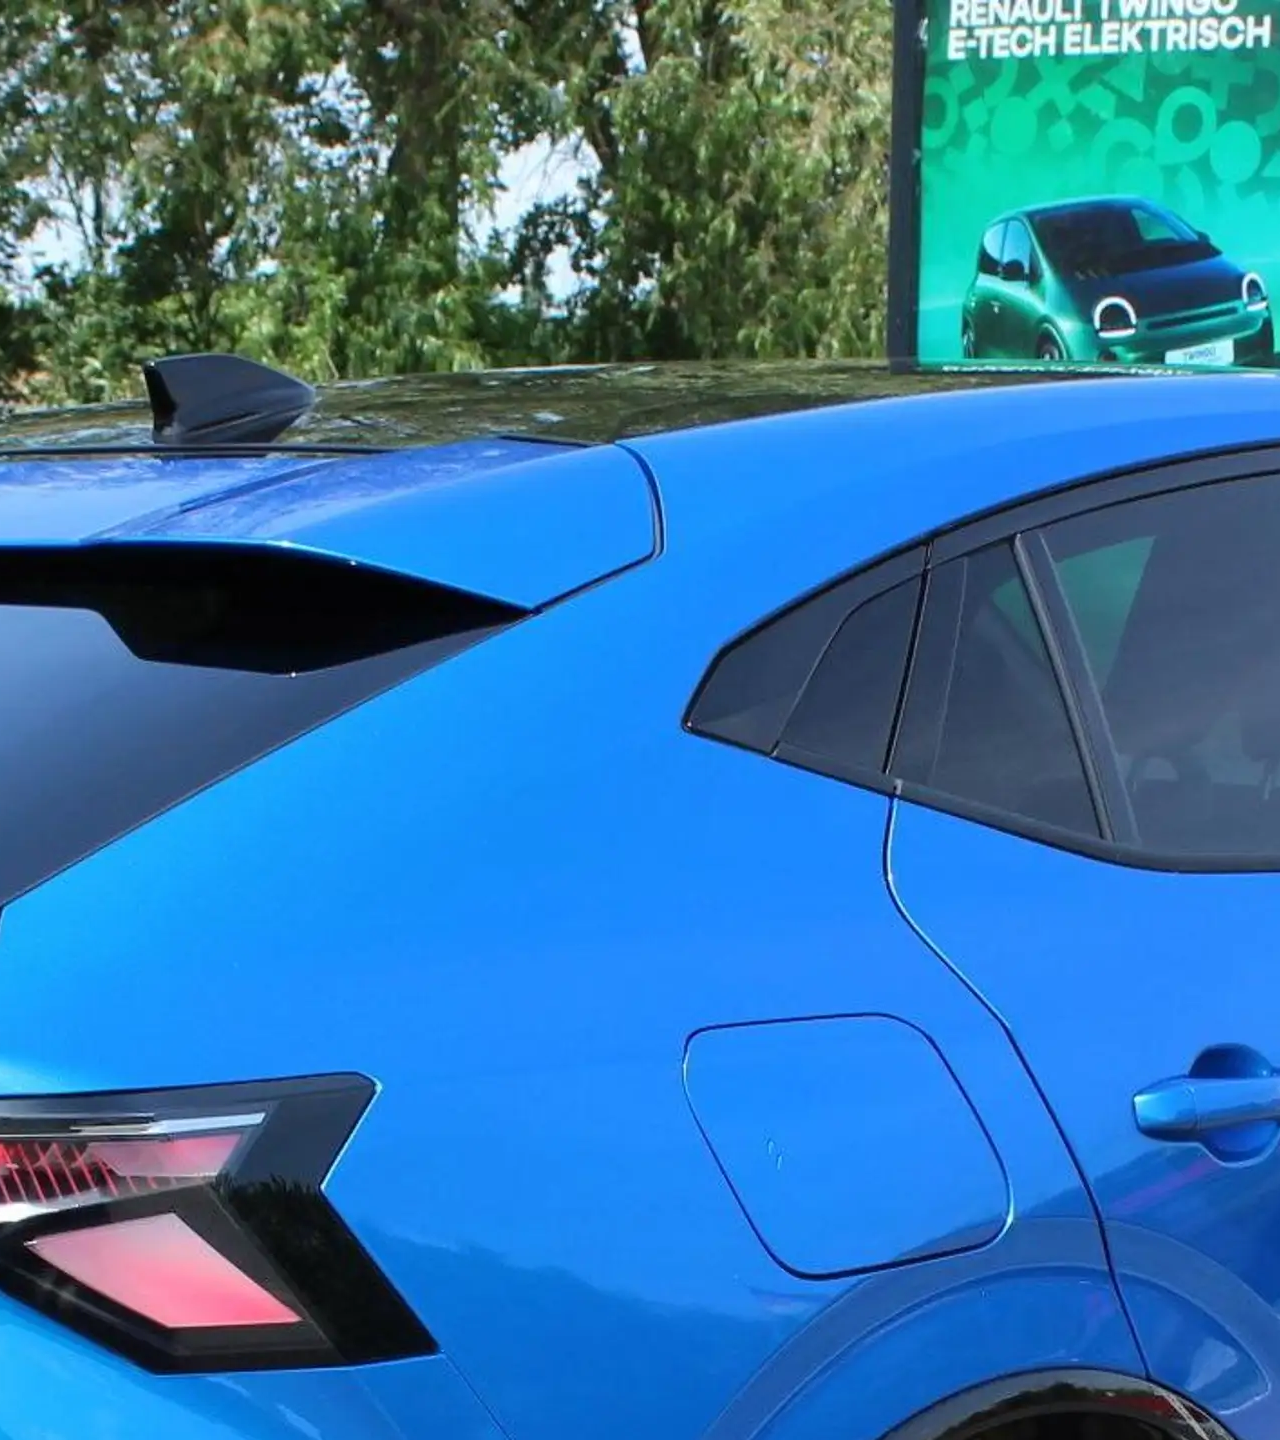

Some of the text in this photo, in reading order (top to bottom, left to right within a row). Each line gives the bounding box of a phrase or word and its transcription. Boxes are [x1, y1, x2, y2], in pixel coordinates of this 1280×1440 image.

[950, 0, 1082, 27] RENAULT
[947, 14, 1272, 60] E-TECH ELEKTRISCH
